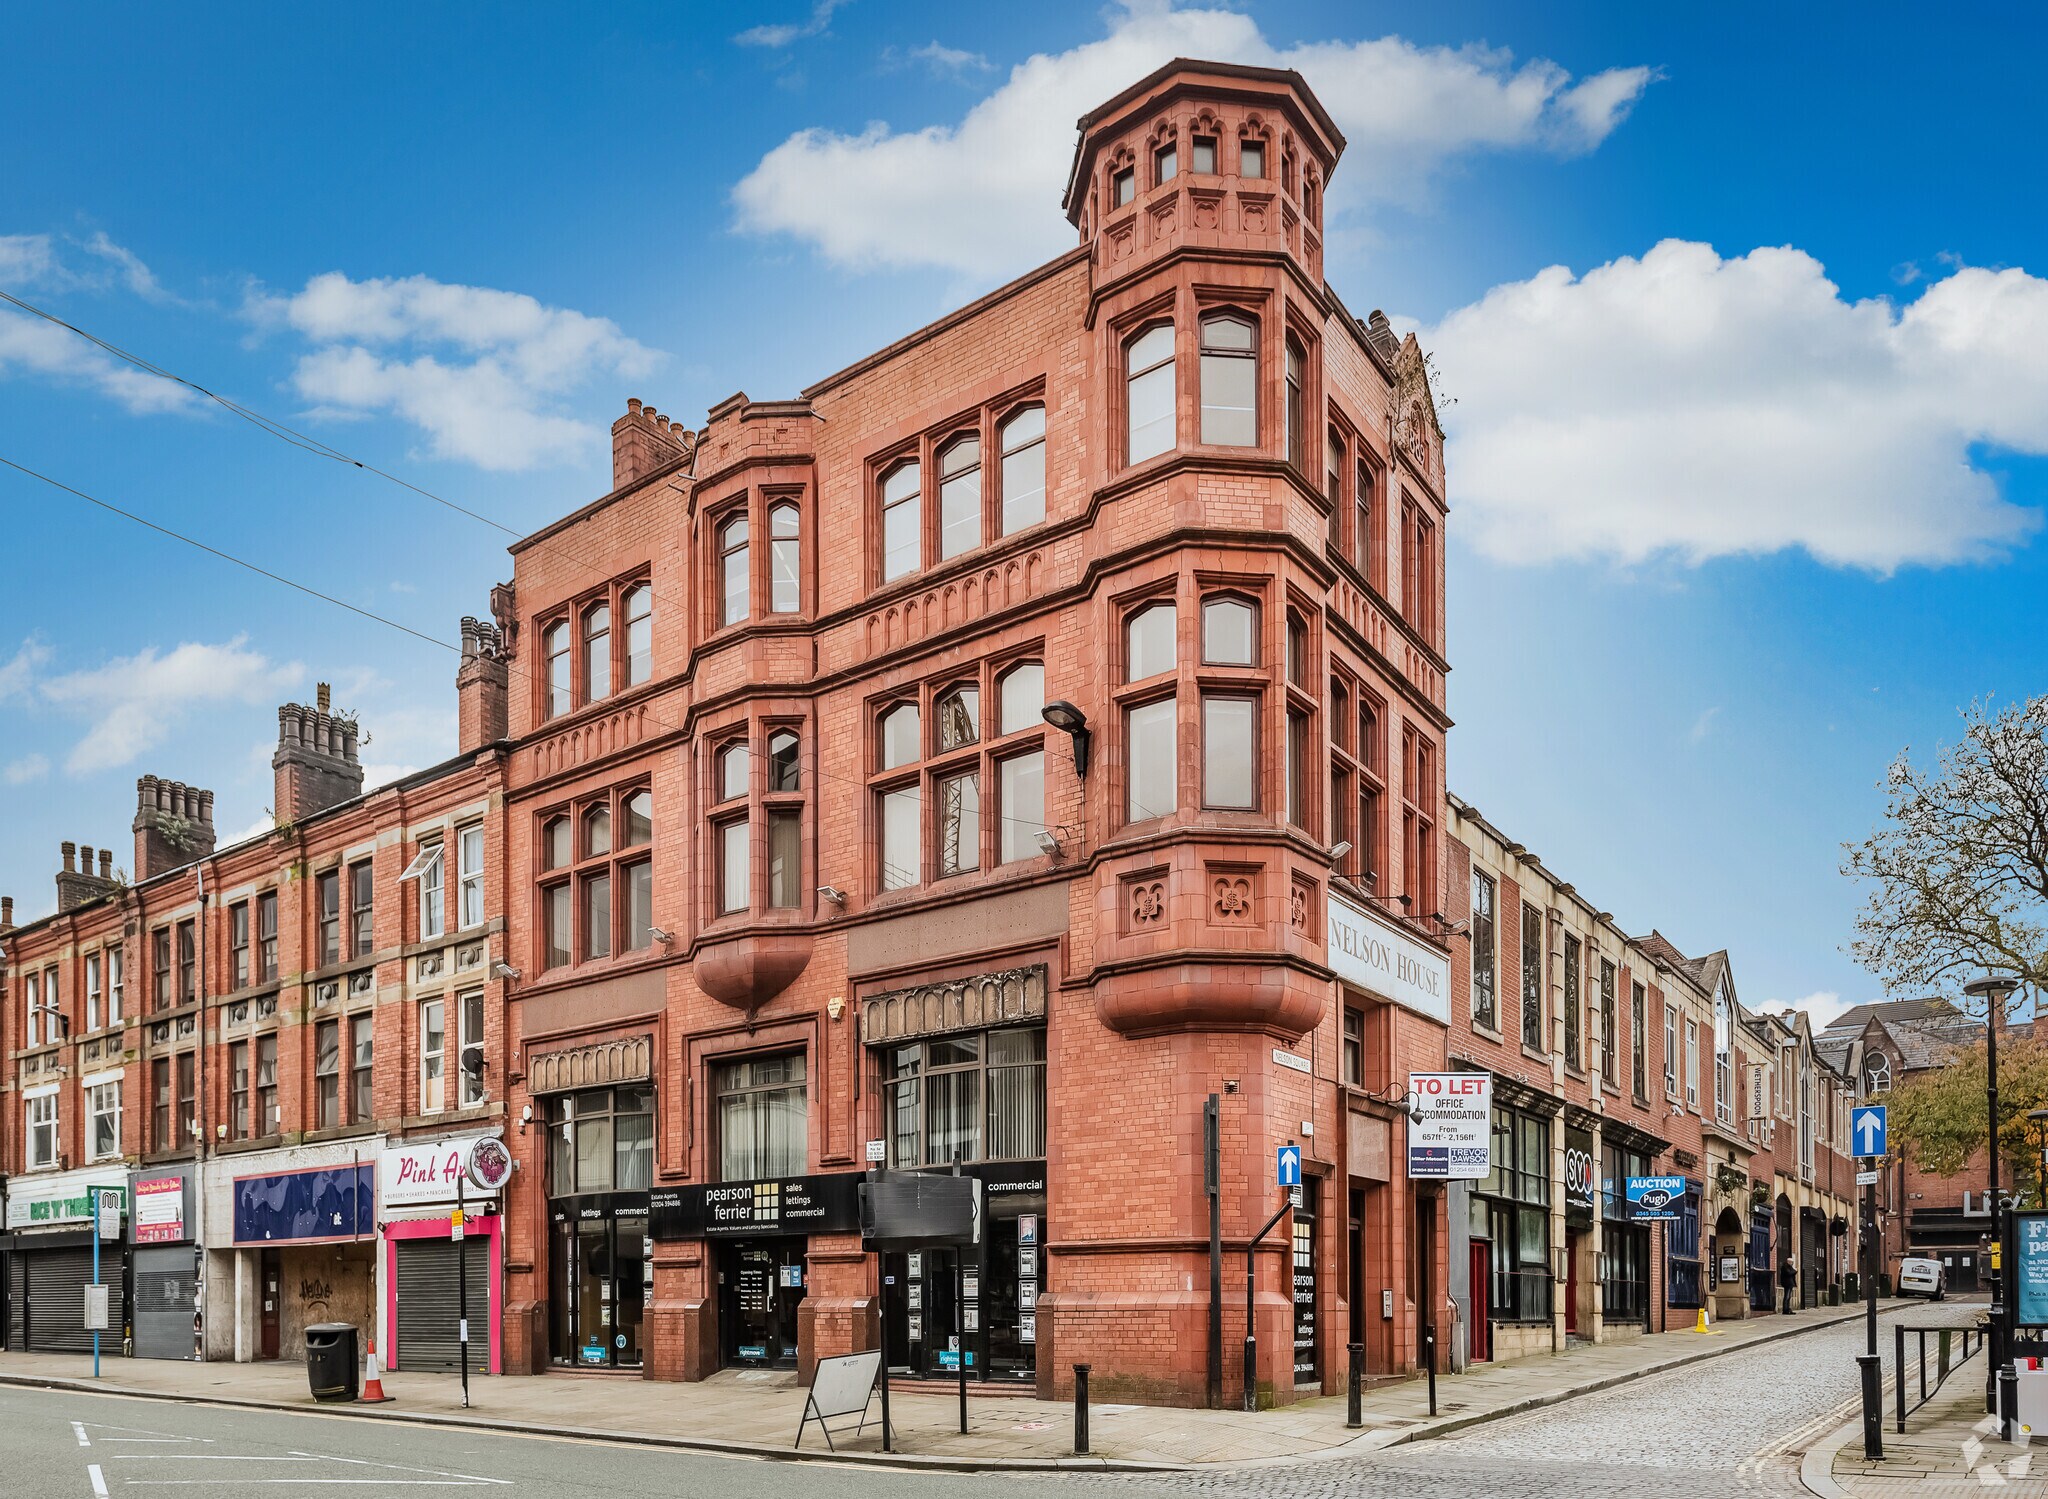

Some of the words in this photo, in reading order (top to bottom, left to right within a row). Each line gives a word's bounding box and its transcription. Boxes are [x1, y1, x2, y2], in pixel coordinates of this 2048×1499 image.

[1330, 917, 1391, 974] NELSON
[1397, 952, 1440, 998] HOUSE
[1274, 1050, 1292, 1065] NELSON
[1414, 1078, 1442, 1095] TO
[1449, 1079, 1486, 1095] LET
[1435, 1098, 1464, 1109] OFFICE
[1419, 1109, 1486, 1120] CCOMMODATION
[1438, 1125, 1458, 1133] From
[1451, 1148, 1487, 1156] TREVOR
[1451, 1155, 1488, 1163] DAWSON
[397, 1155, 436, 1186] Pink
[786, 1183, 803, 1192] sales
[987, 1179, 1043, 1191] commercial
[1630, 1178, 1681, 1189] AUCTION
[663, 1192, 678, 1200] Agents
[706, 1186, 752, 1206] pearson
[786, 1196, 811, 1206] lettings
[1643, 1193, 1667, 1205] Pugh
[555, 1212, 565, 1221] sales
[581, 1209, 601, 1218] lettings
[615, 1207, 649, 1216] commerci
[714, 1204, 752, 1220] ferrier
[786, 1207, 825, 1218] commercial
[1293, 1274, 1314, 1286] earson
[2029, 1271, 2043, 1279] Way
[1293, 1288, 1314, 1303] ferrier
[1303, 1311, 1314, 1321] sales
[1298, 1324, 1314, 1336] lettings
[739, 1349, 761, 1357] rightmove
